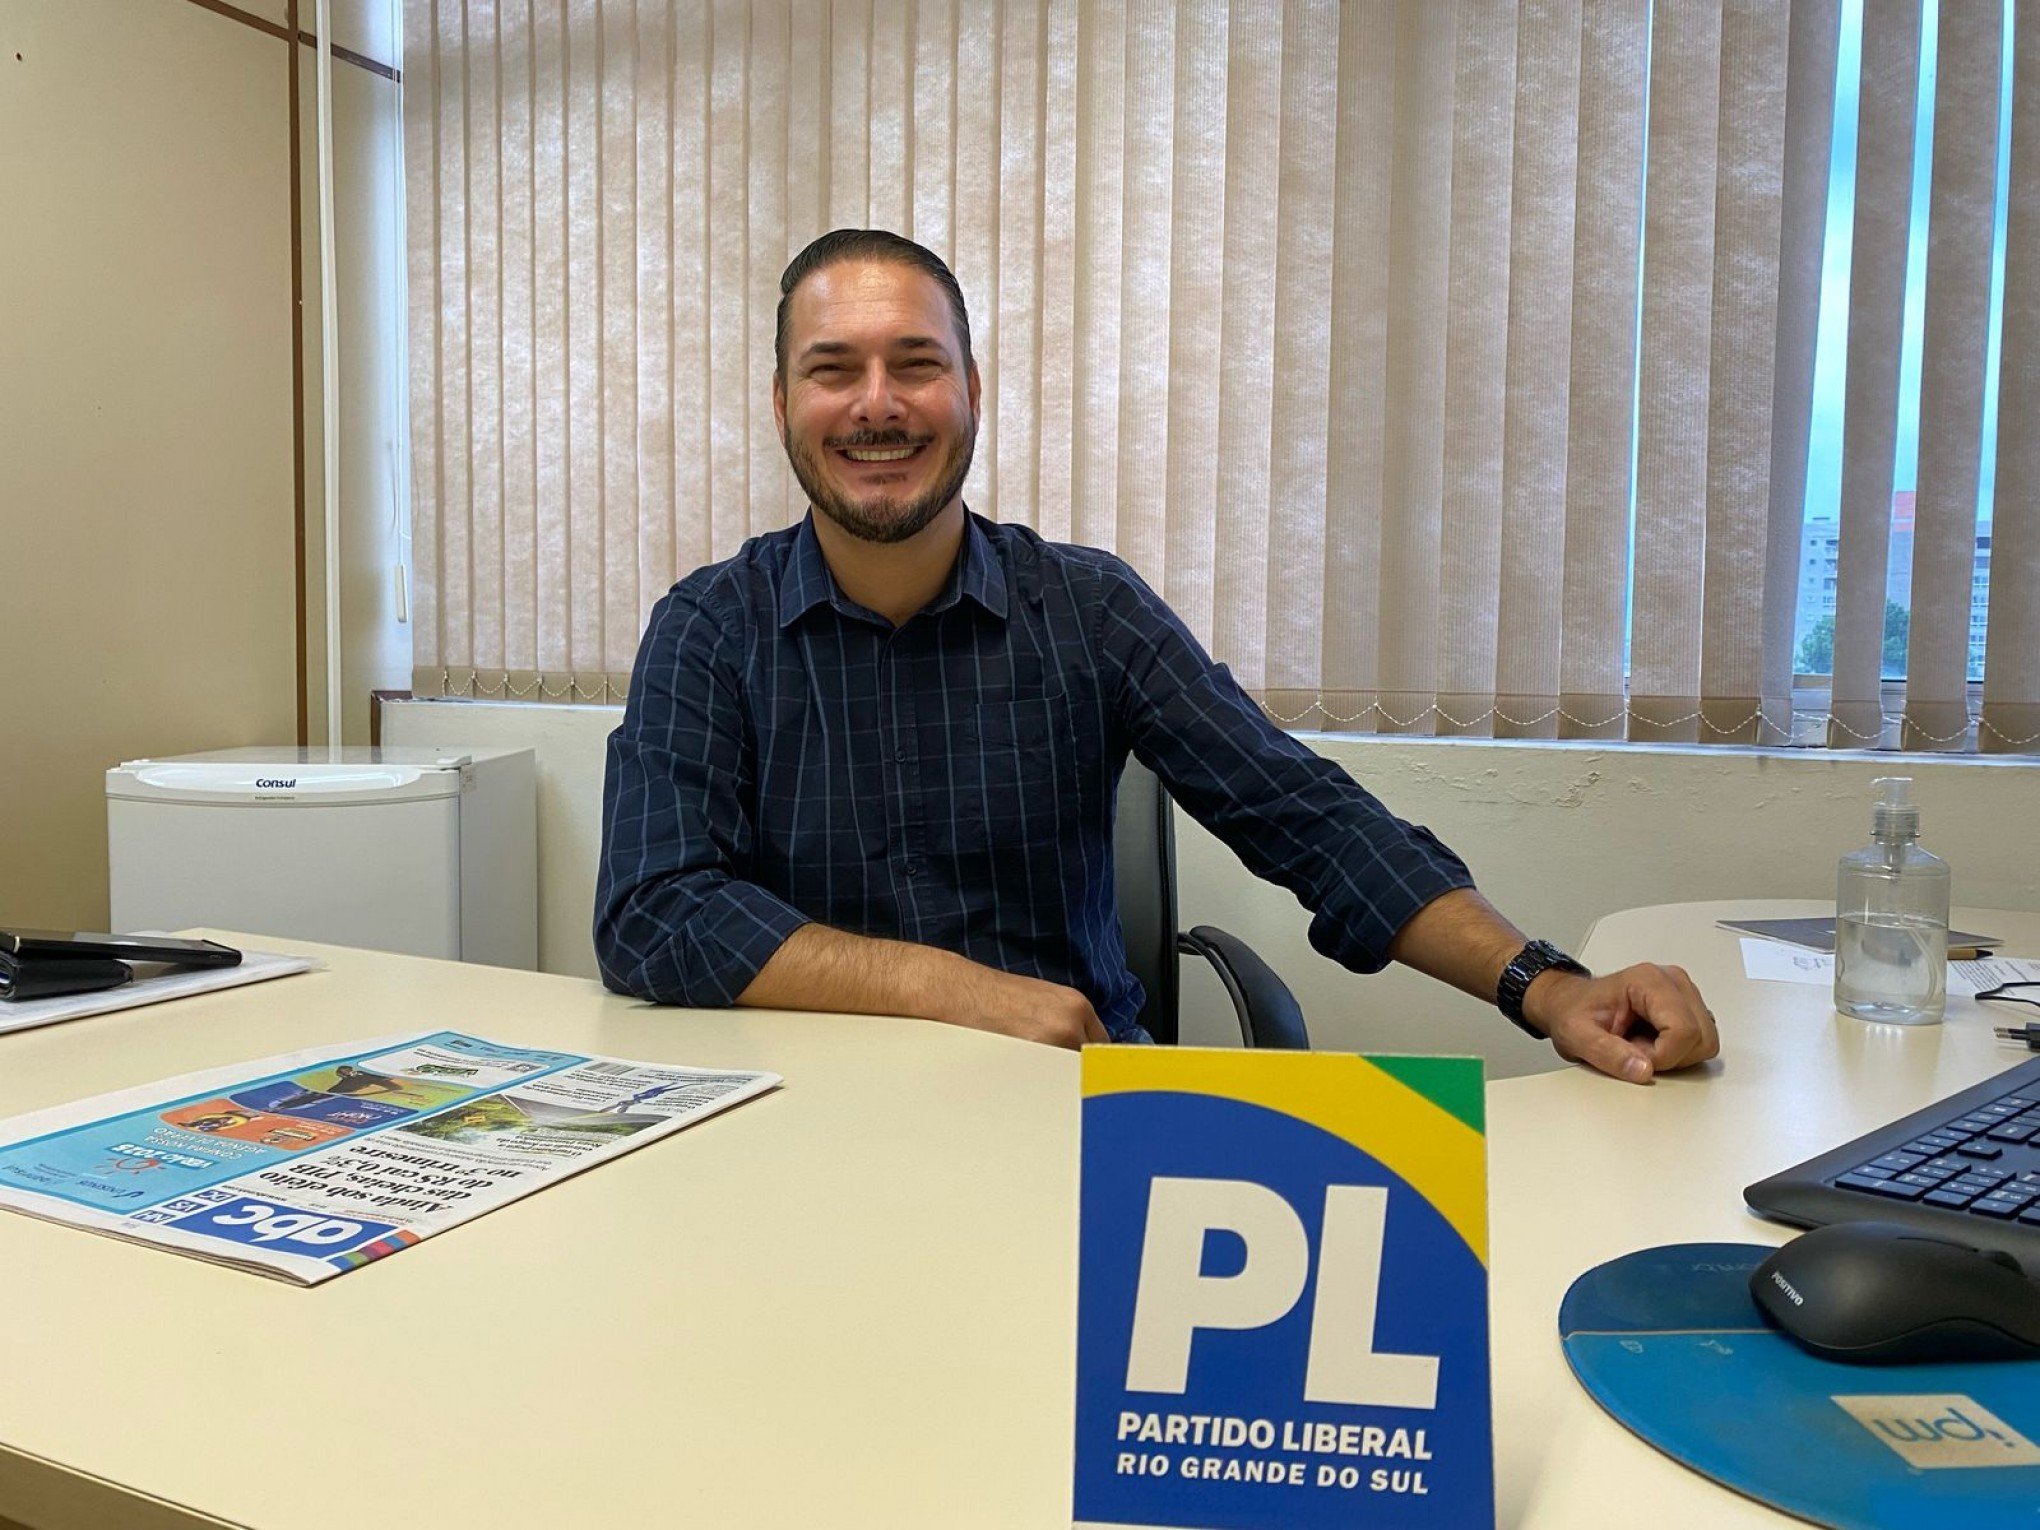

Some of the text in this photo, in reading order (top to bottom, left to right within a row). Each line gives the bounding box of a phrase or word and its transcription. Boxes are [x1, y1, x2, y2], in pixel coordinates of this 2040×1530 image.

[255, 778, 297, 788] Consul
[348, 1146, 461, 1172] trimestre
[373, 1167, 420, 1178] cai
[486, 1169, 523, 1179] no
[260, 1172, 453, 1213] Ainda sob efeito
[288, 1164, 472, 1201] das cheias, PIB
[413, 1175, 461, 1187] RS
[458, 1179, 493, 1189] do
[168, 1201, 197, 1212] VS
[212, 1205, 363, 1245] abc
[1125, 1176, 1440, 1410] PL
[1771, 1271, 1804, 1306] POSITIVO
[1117, 1411, 1433, 1460] PARTIDO LIBERAL
[1116, 1452, 1429, 1495] RIO GRANDE DO SUL
